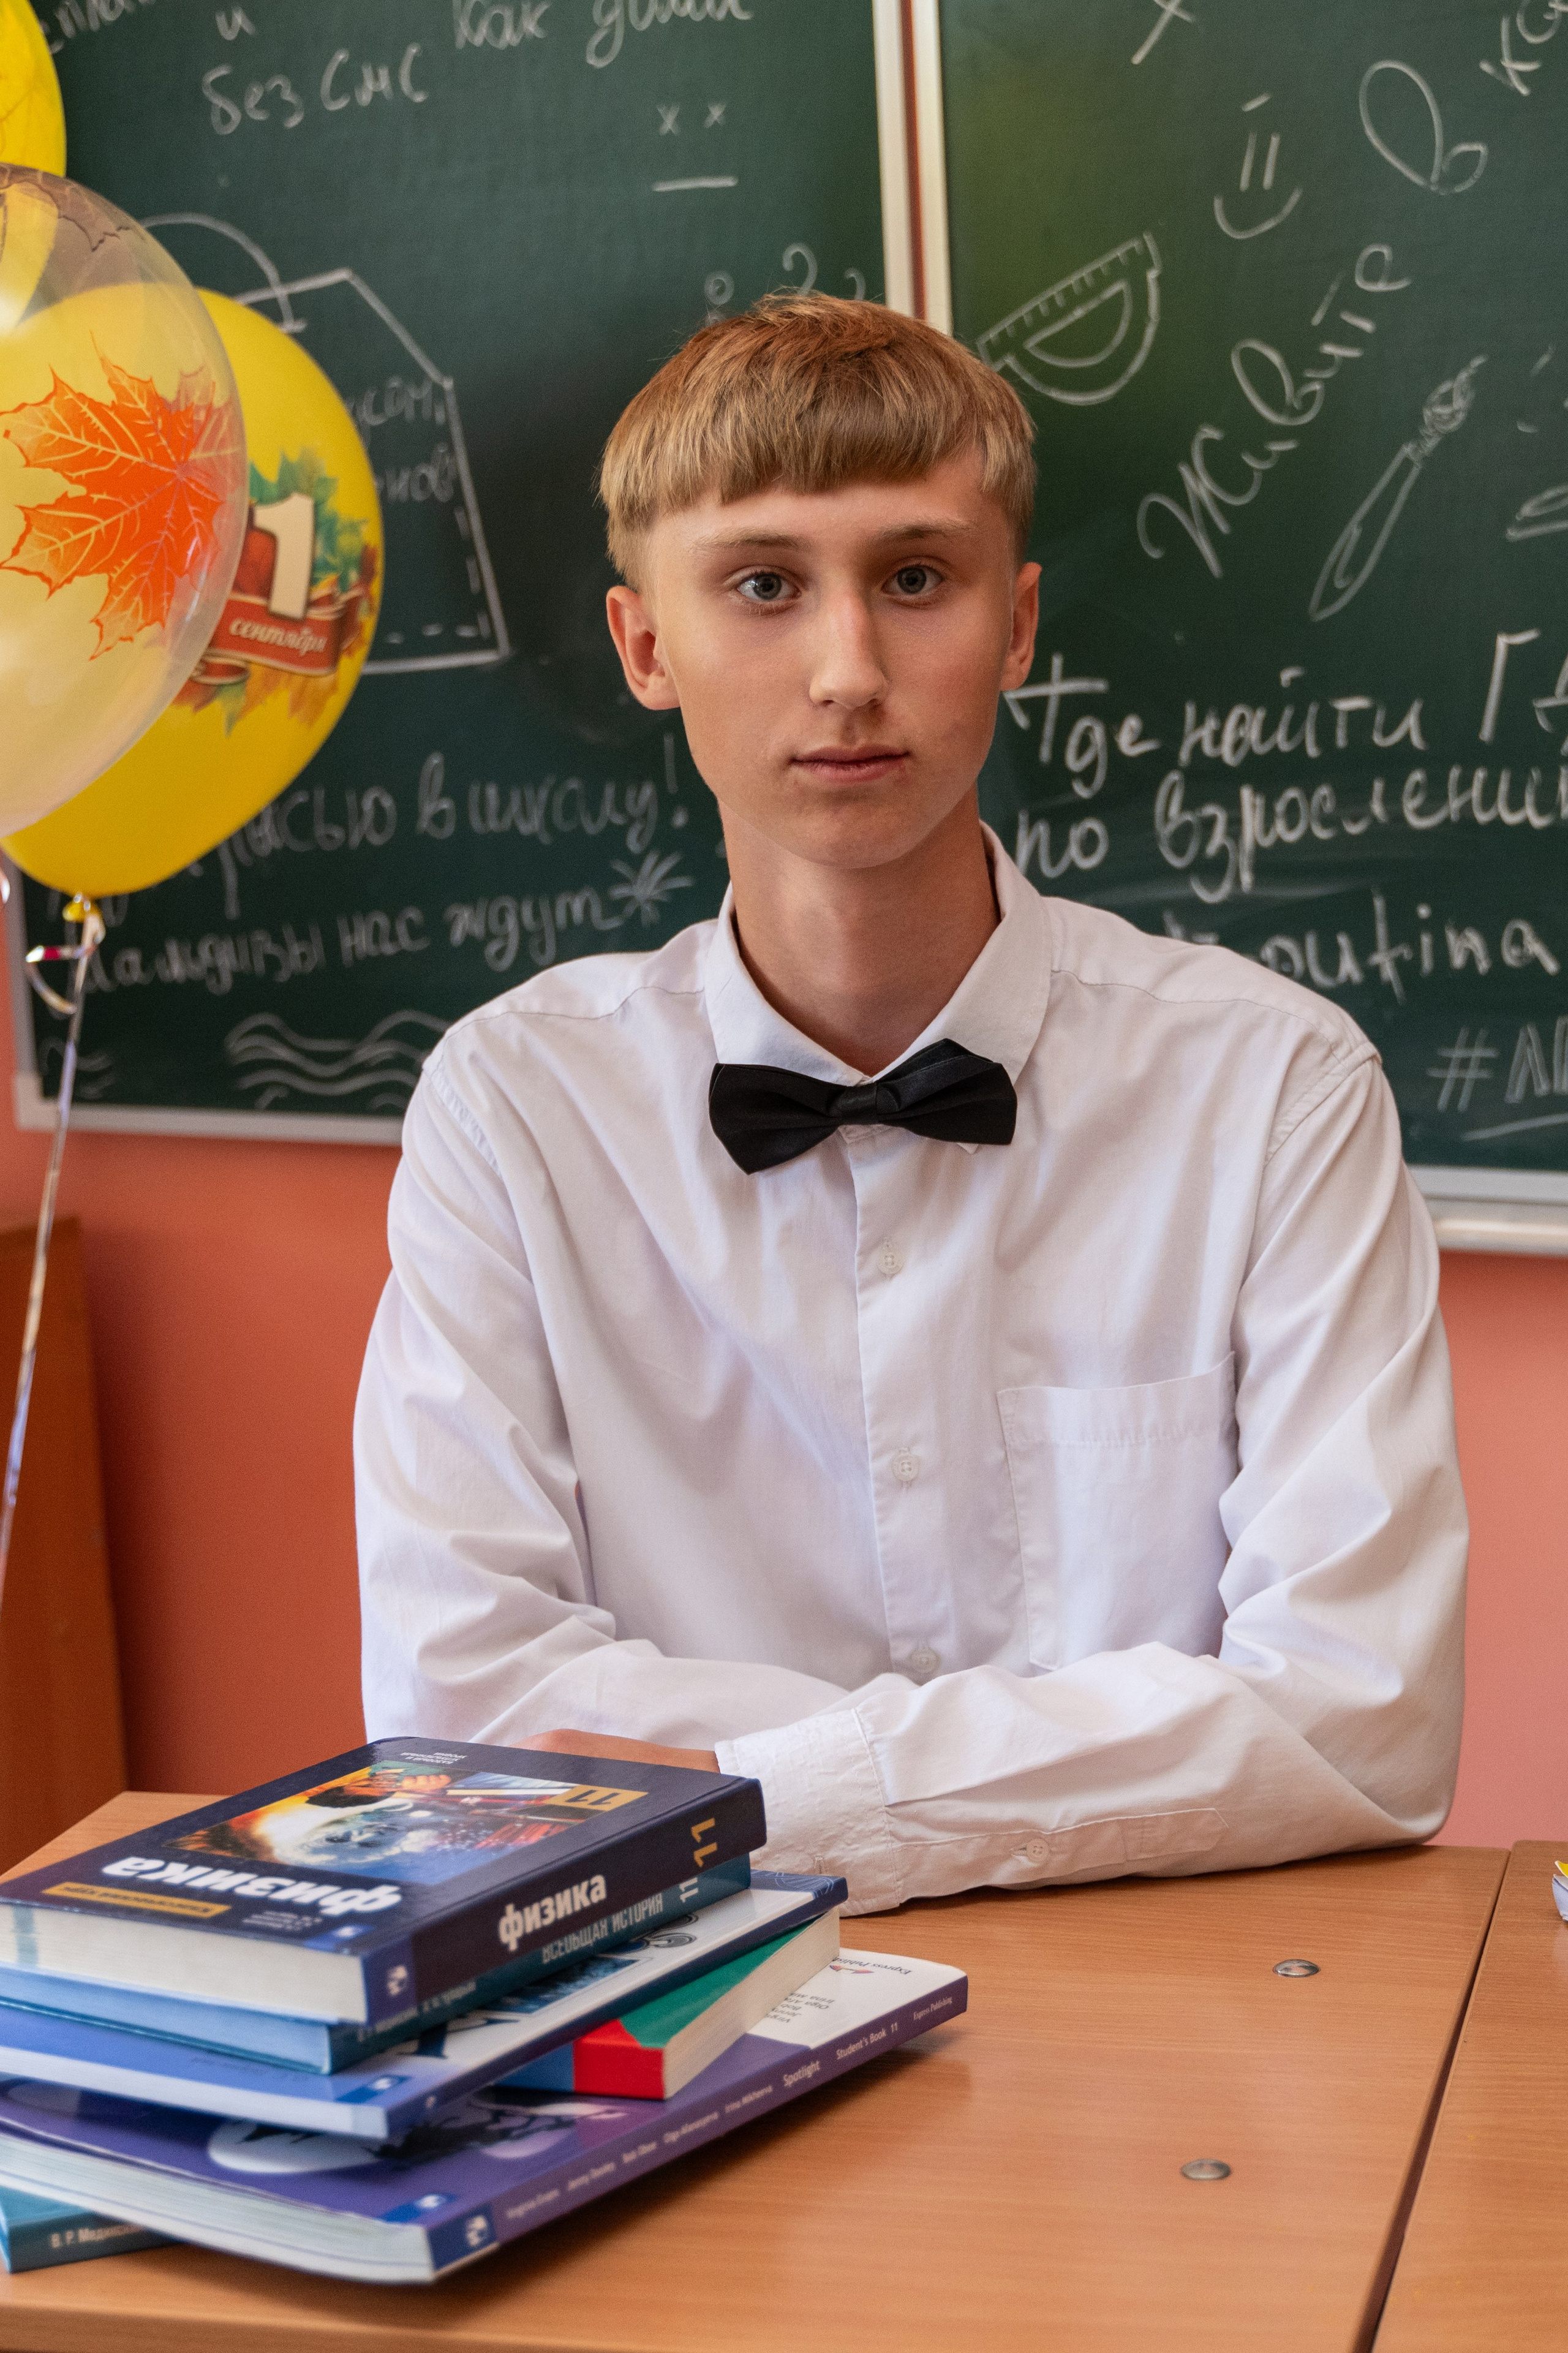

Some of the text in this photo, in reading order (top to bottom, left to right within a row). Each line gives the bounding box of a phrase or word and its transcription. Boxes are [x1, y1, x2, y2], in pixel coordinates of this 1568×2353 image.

[252, 491, 315, 620] 1
[1177, 665, 1427, 768] найти
[337, 904, 430, 968] нас
[565, 1789, 620, 1806] 11
[498, 1817, 718, 1953] физика 11
[678, 1876, 699, 1903] 11
[871, 1962, 912, 1975] Express
[804, 2001, 829, 2009] Olga
[783, 2060, 821, 2088] Spotlight
[835, 2036, 869, 2060] Student's
[869, 2028, 887, 2044] Book
[890, 2021, 899, 2034] 11
